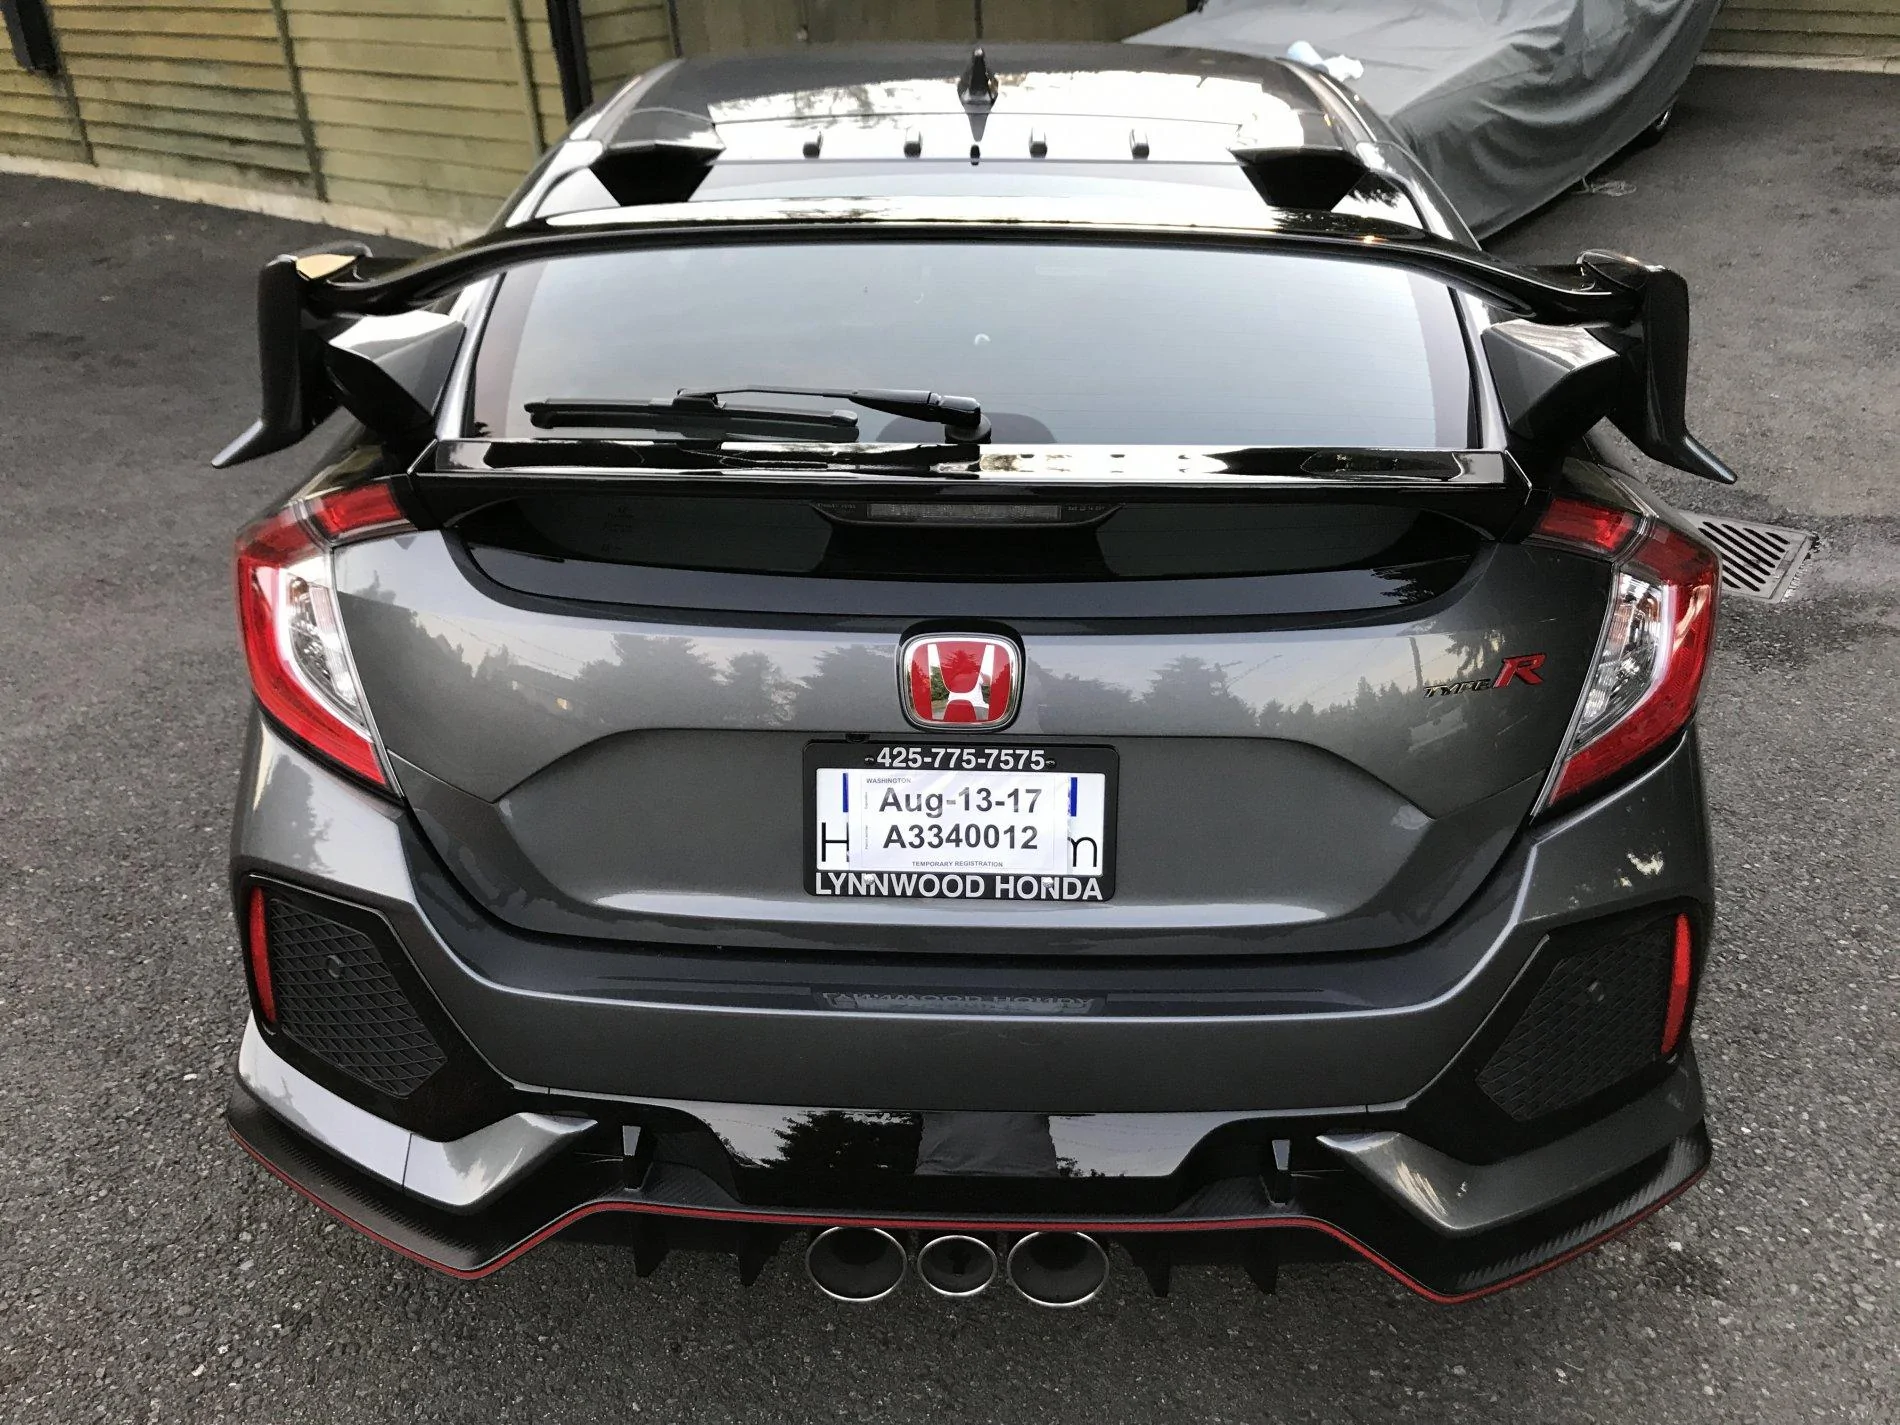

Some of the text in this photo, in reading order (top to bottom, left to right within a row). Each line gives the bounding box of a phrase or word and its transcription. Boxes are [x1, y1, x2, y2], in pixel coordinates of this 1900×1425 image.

[1423, 653, 1547, 698] TYPE R
[876, 747, 1046, 770] 425-775-7575
[879, 787, 1042, 818] Aug-13-17
[883, 823, 1038, 849] A3340012
[815, 872, 1103, 900] LYNNWOOD HONDA
